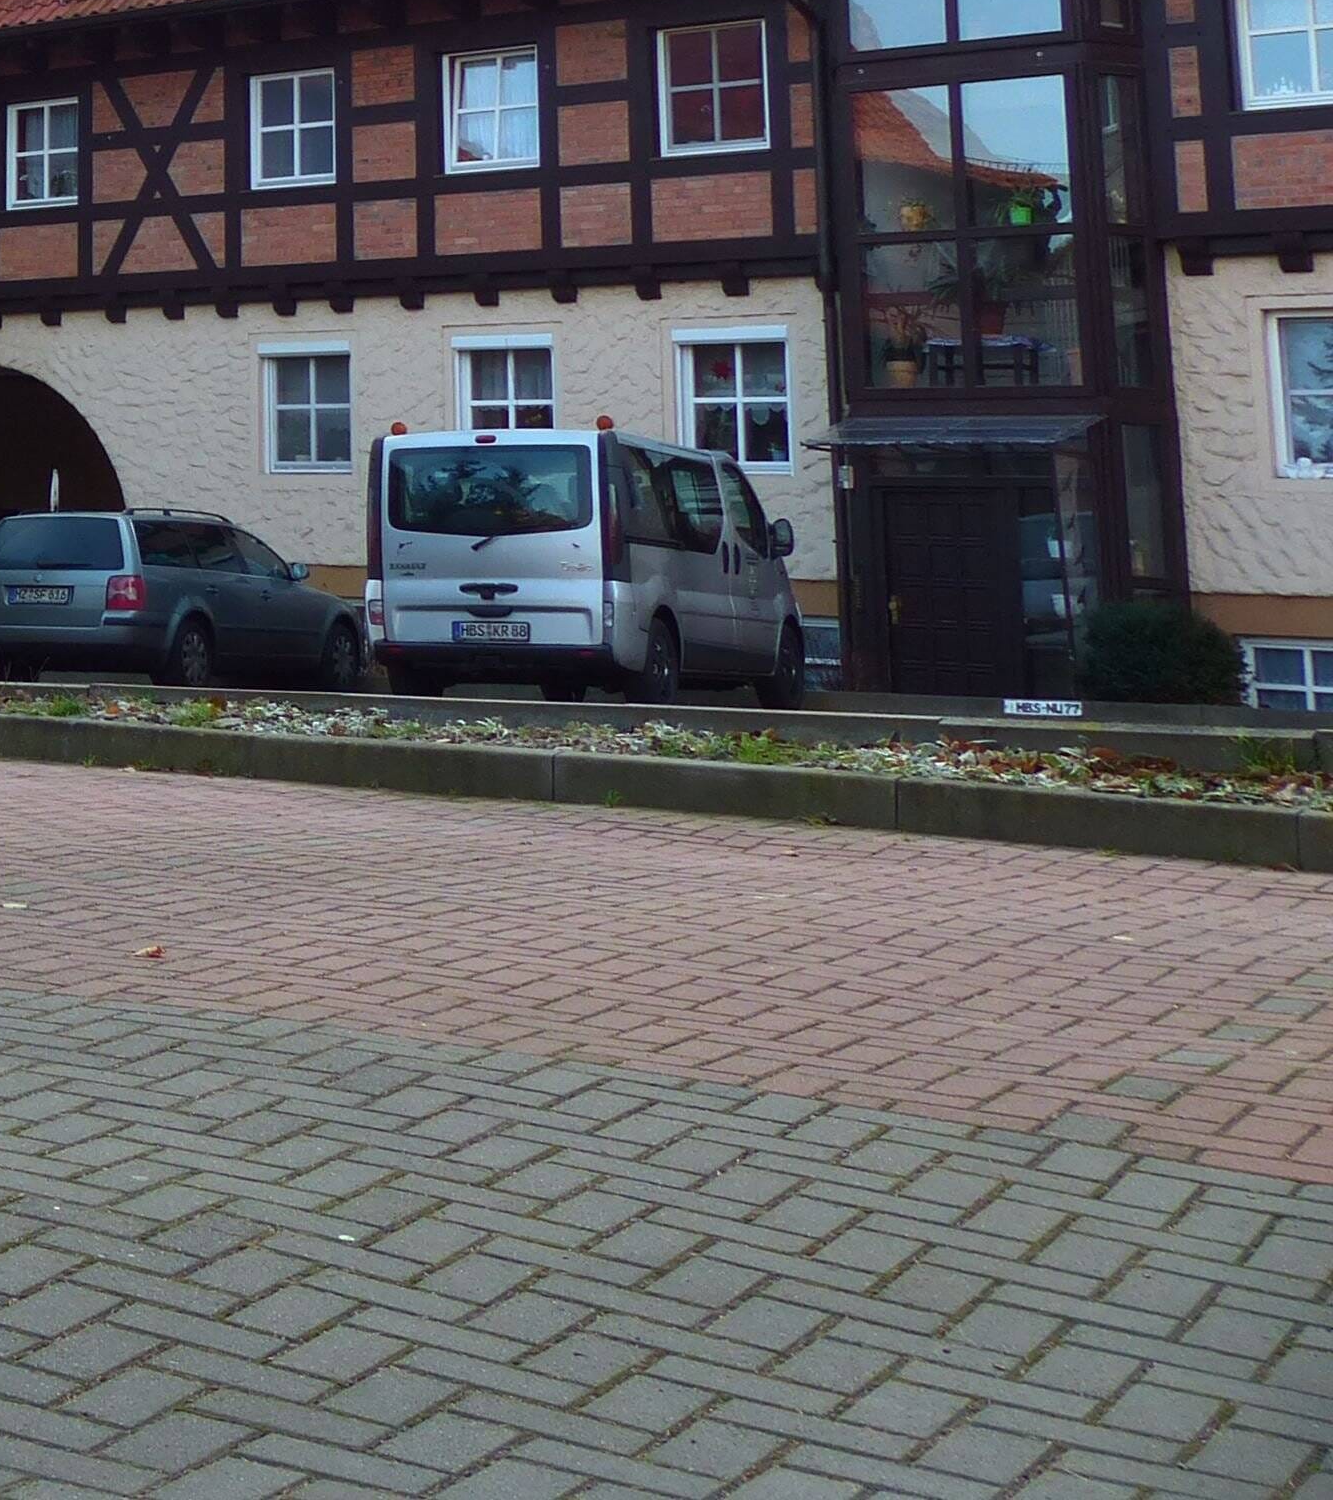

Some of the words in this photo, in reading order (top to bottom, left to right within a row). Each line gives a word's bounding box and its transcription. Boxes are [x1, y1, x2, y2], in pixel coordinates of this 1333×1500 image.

[460, 624, 485, 637] HBS
[493, 624, 509, 637] KR
[511, 625, 527, 638] 88
